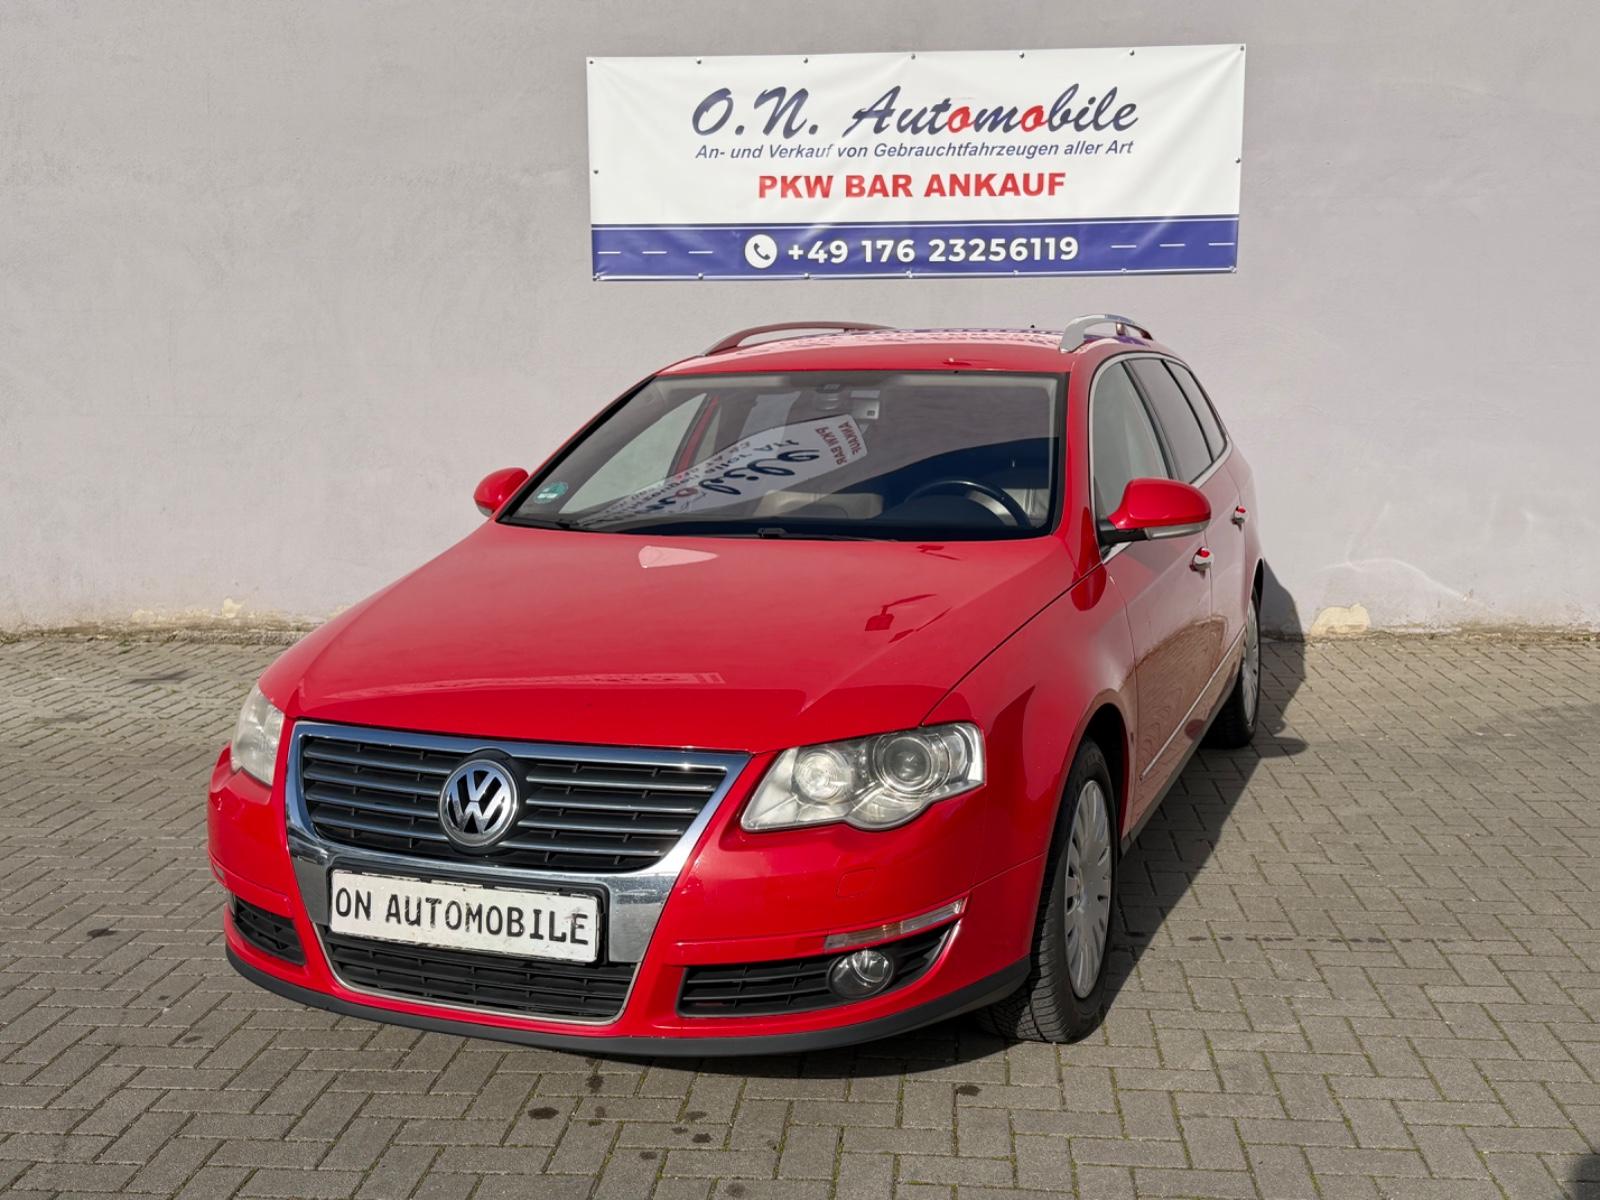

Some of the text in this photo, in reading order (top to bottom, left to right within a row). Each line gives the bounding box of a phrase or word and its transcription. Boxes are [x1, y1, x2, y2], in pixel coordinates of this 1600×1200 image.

[841, 83, 1139, 137] Automobile
[695, 139, 1134, 160] An- und Verkauf von Gebrauchtfahrzeugen aller Art
[758, 172, 1067, 199] PKW BAR ANKAUF
[788, 236, 1079, 264] +49 176 23256119
[335, 886, 590, 946] ON AUTOMOBILE
